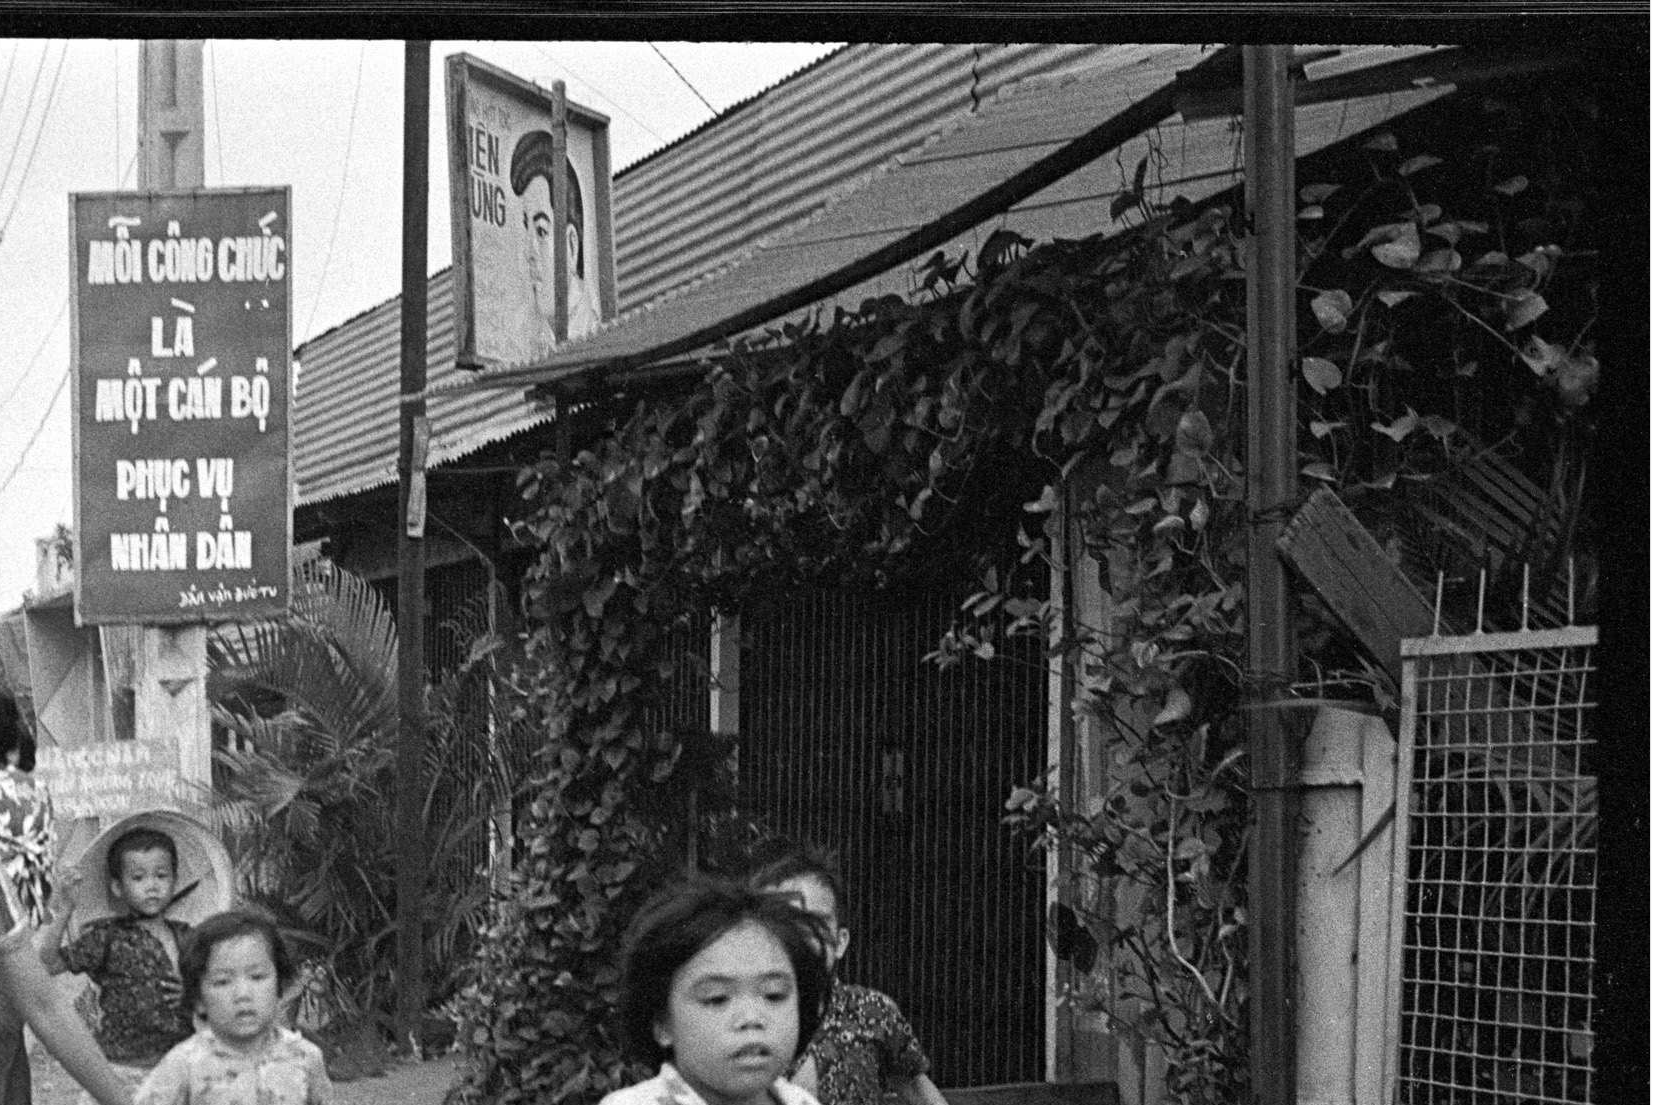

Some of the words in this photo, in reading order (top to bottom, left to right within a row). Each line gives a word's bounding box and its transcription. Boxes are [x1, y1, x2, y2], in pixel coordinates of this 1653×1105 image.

[87, 214, 143, 285] MỖI
[147, 219, 214, 283] CÔNG
[217, 210, 286, 283] CHỨC
[150, 297, 196, 358] LÀ
[95, 357, 163, 434] MỘT
[167, 356, 223, 421] CÁN
[230, 356, 270, 433] BỘ
[115, 458, 191, 513] PHỤC
[196, 457, 234, 512] VỤ
[110, 516, 187, 571] NHÂN
[195, 513, 253, 570] DÂN
